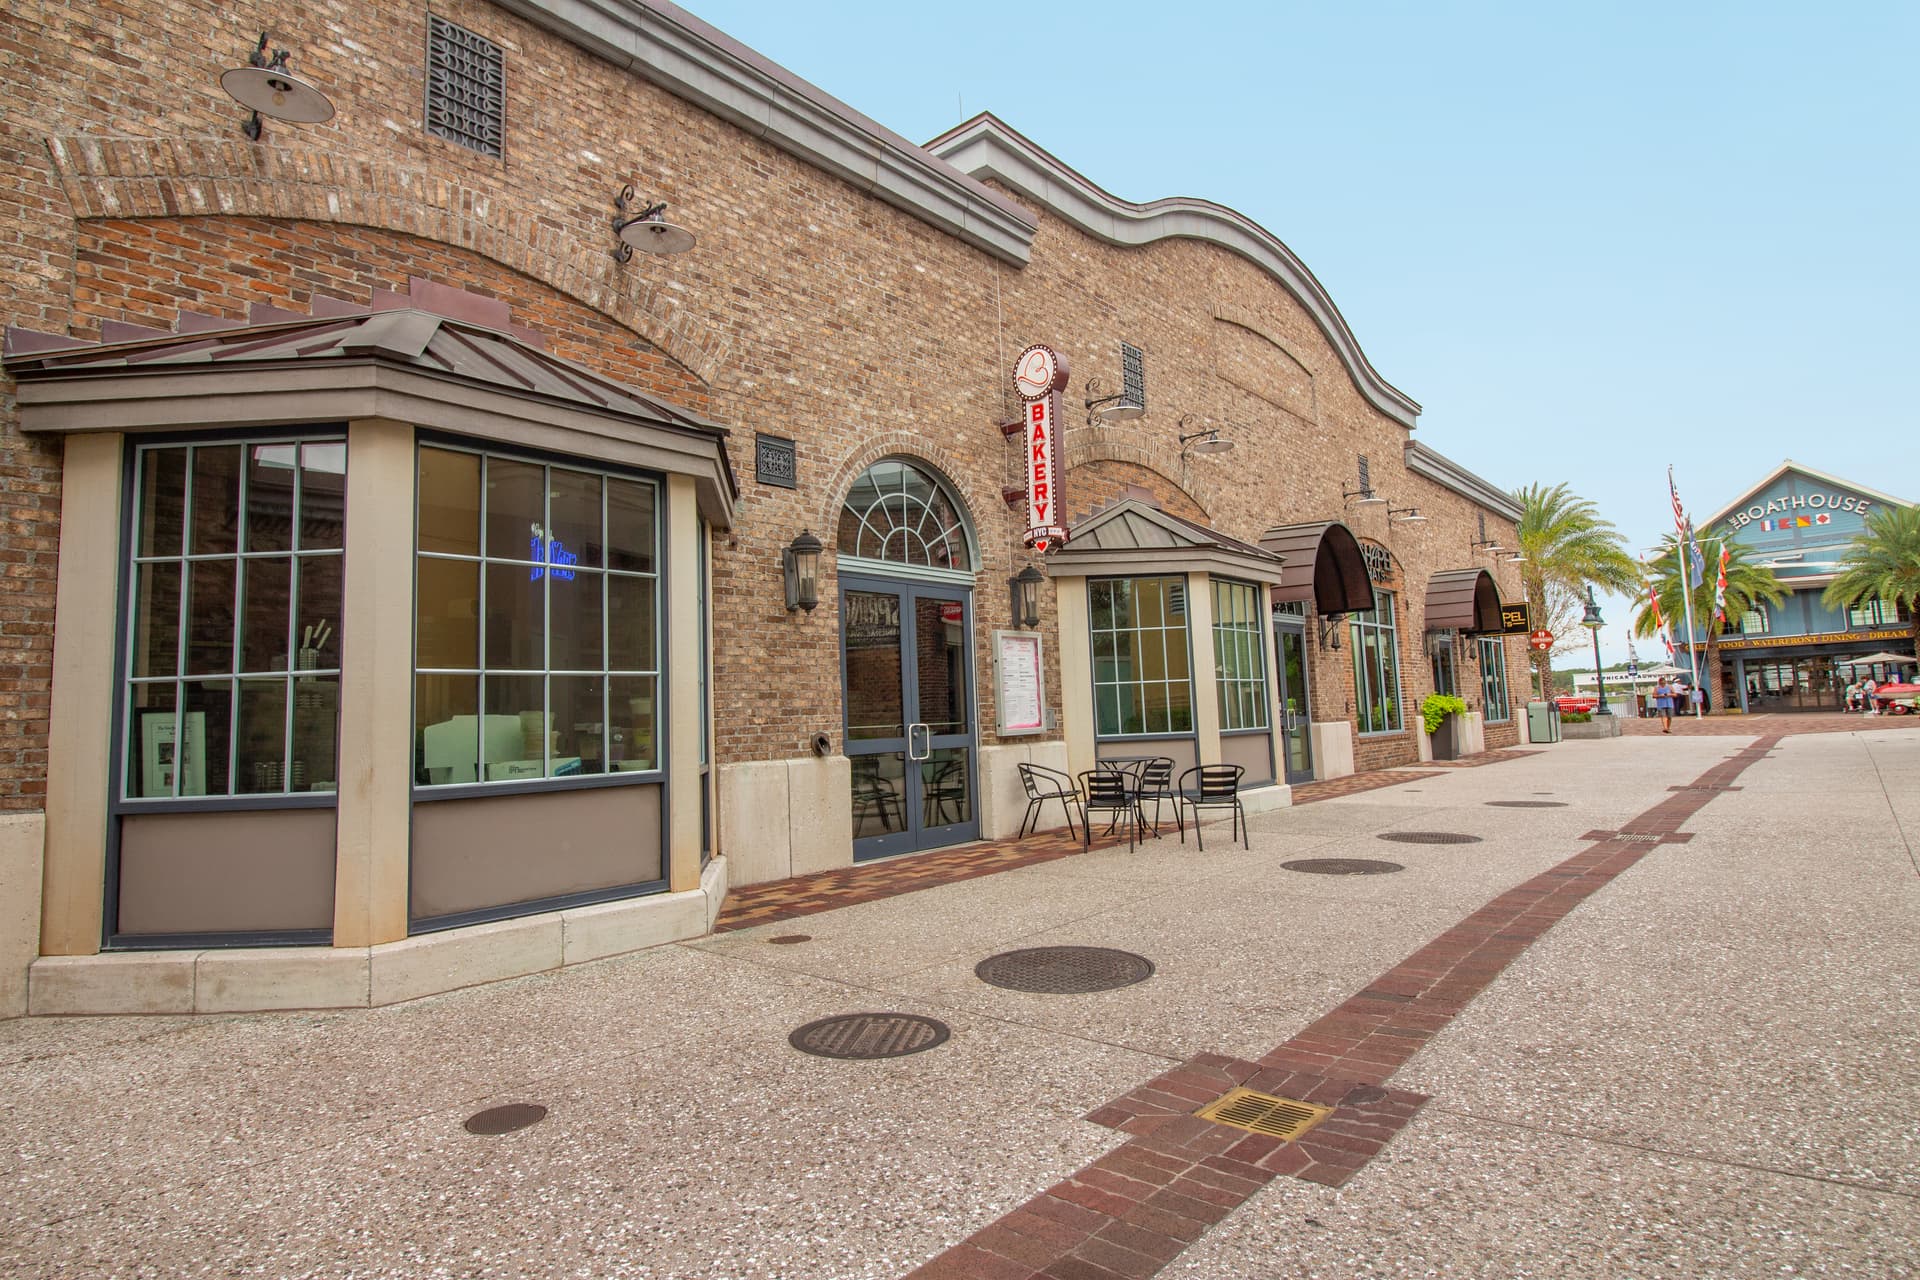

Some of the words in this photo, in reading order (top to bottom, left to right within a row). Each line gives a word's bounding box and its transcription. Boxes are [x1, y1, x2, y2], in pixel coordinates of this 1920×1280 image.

[1030, 402, 1048, 522] BAKERY
[1736, 494, 1871, 526] BOATHOUSE
[1033, 527, 1047, 538] NYC
[1718, 641, 1745, 649] FOOD
[1752, 635, 1818, 647] WATERFRONT
[1821, 633, 1860, 642] DINING
[1869, 630, 1908, 640] DREAM
